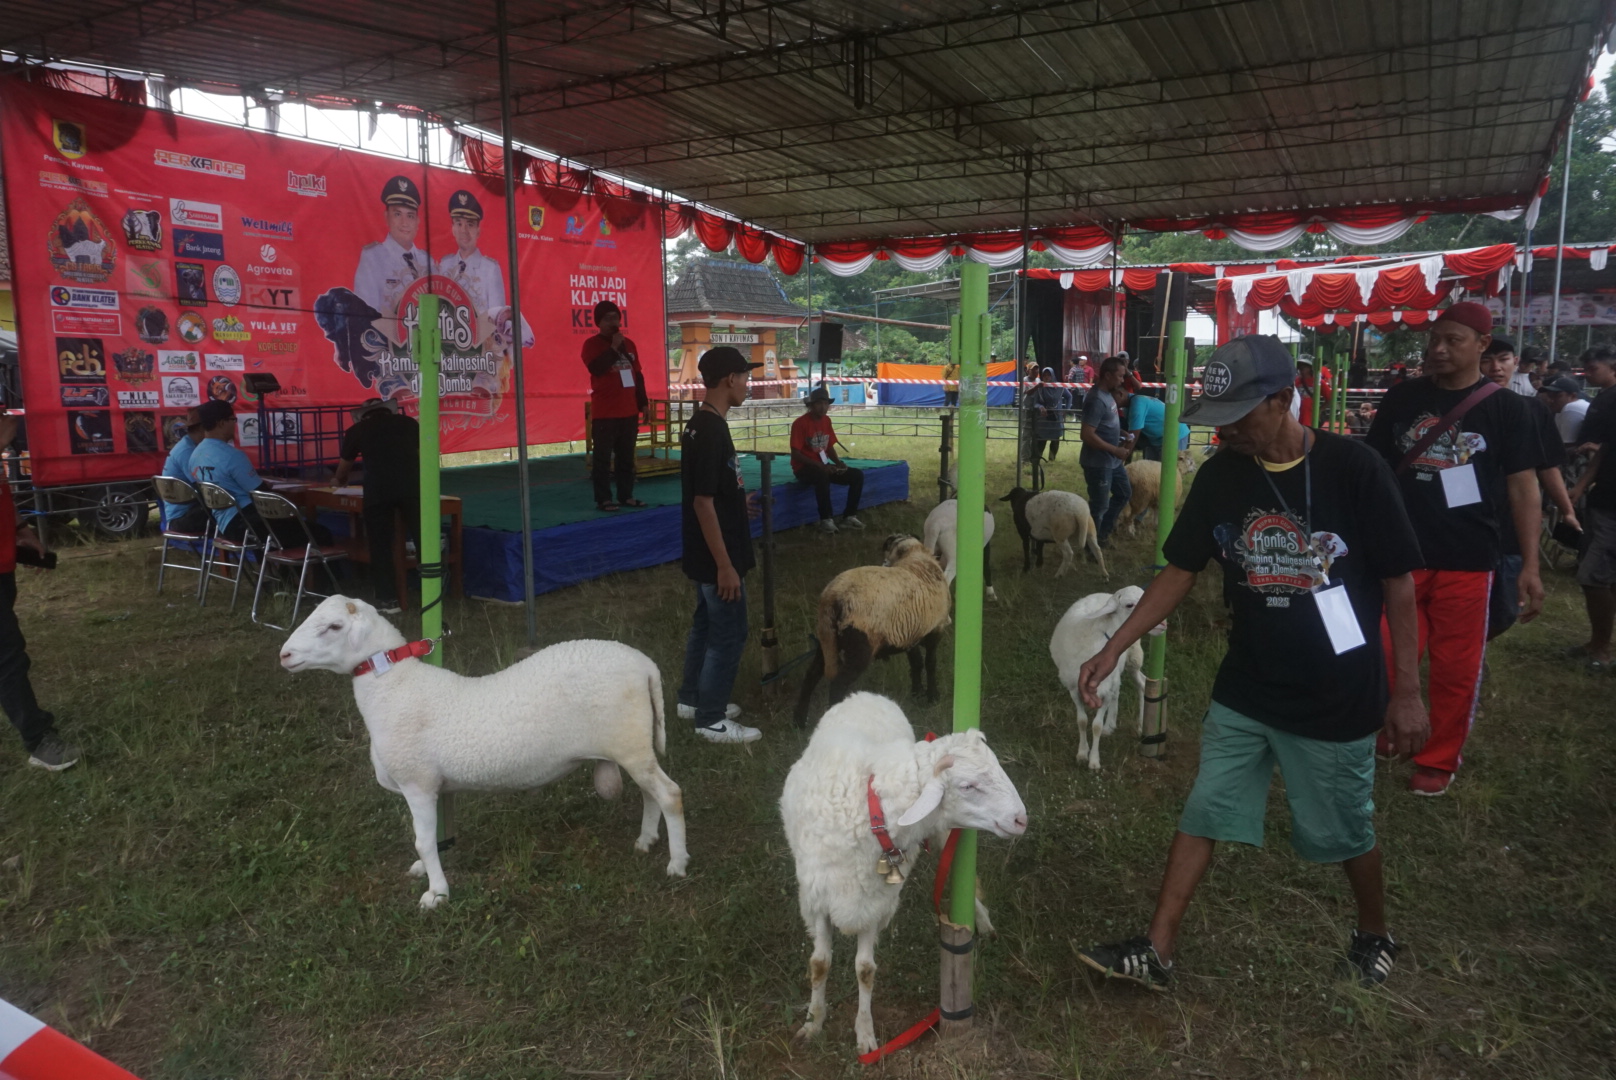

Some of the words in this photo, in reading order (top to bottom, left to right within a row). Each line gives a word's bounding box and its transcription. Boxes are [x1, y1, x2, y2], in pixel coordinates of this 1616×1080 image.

[72, 161, 104, 173] Kayumas
[241, 217, 293, 235] Wellmilk
[185, 243, 201, 252] Bank
[202, 245, 221, 255] Jateng
[247, 264, 293, 276] Agroveta
[579, 263, 617, 273] Memperingati
[570, 274, 598, 288] HARI
[600, 276, 626, 290] JADI
[72, 293, 91, 302] BANK
[92, 295, 116, 304] KLATEN
[571, 290, 627, 307] KLATEN
[280, 322, 297, 331] VET
[404, 303, 472, 350] KteS
[258, 342, 278, 352] KOPIE
[291, 385, 306, 395] Pos
[1280, 519, 1292, 530] CUP
[1256, 565, 1269, 574] dan
[1271, 564, 1299, 576] Domba
[1266, 596, 1291, 608] 2025
